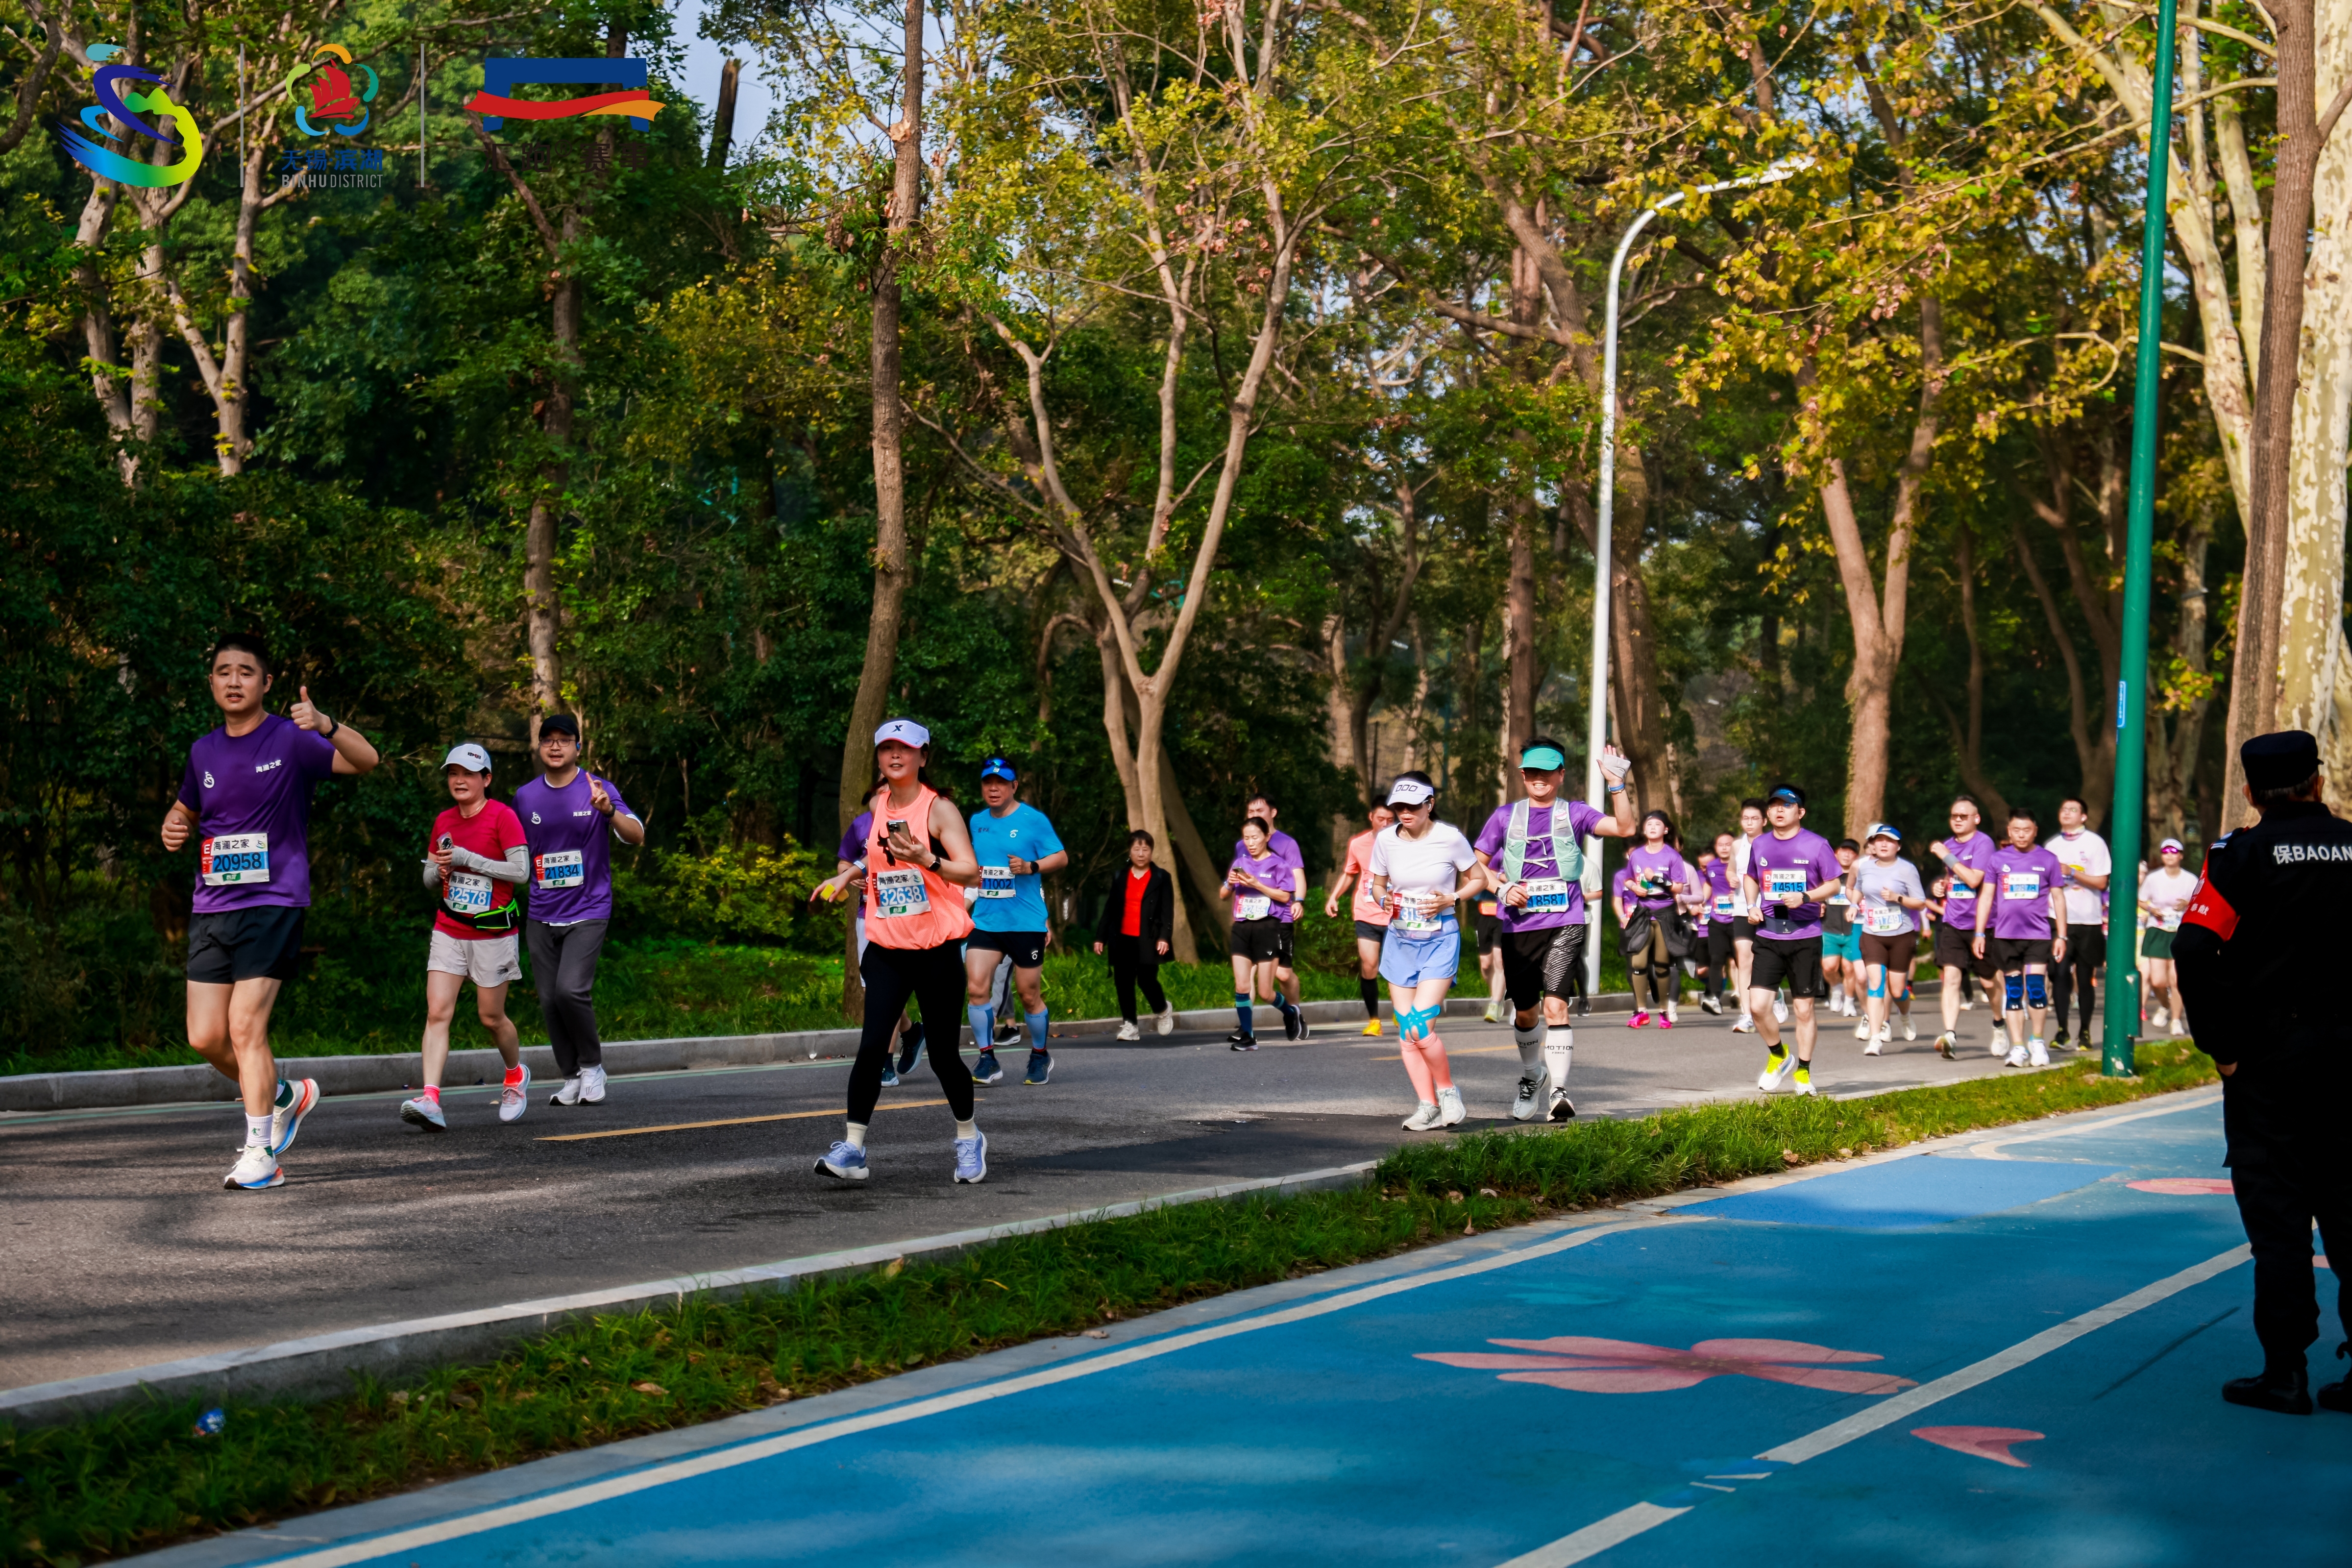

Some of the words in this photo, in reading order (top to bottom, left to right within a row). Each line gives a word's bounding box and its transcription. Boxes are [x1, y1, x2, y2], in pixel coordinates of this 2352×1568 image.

[255, 759, 282, 773] 海澜之家
[204, 844, 211, 854] E
[214, 838, 249, 851] 海澜之家
[214, 852, 262, 872] 20958
[544, 855, 570, 864] 海澜之家
[545, 864, 580, 880] 21834
[451, 875, 480, 887] 海澜之家
[878, 874, 909, 885] 海澜之家
[982, 878, 1012, 890] 11002
[1773, 882, 1804, 892] 14515
[449, 886, 487, 906] 32578
[880, 886, 922, 906] 32638
[1529, 893, 1565, 907] 18587
